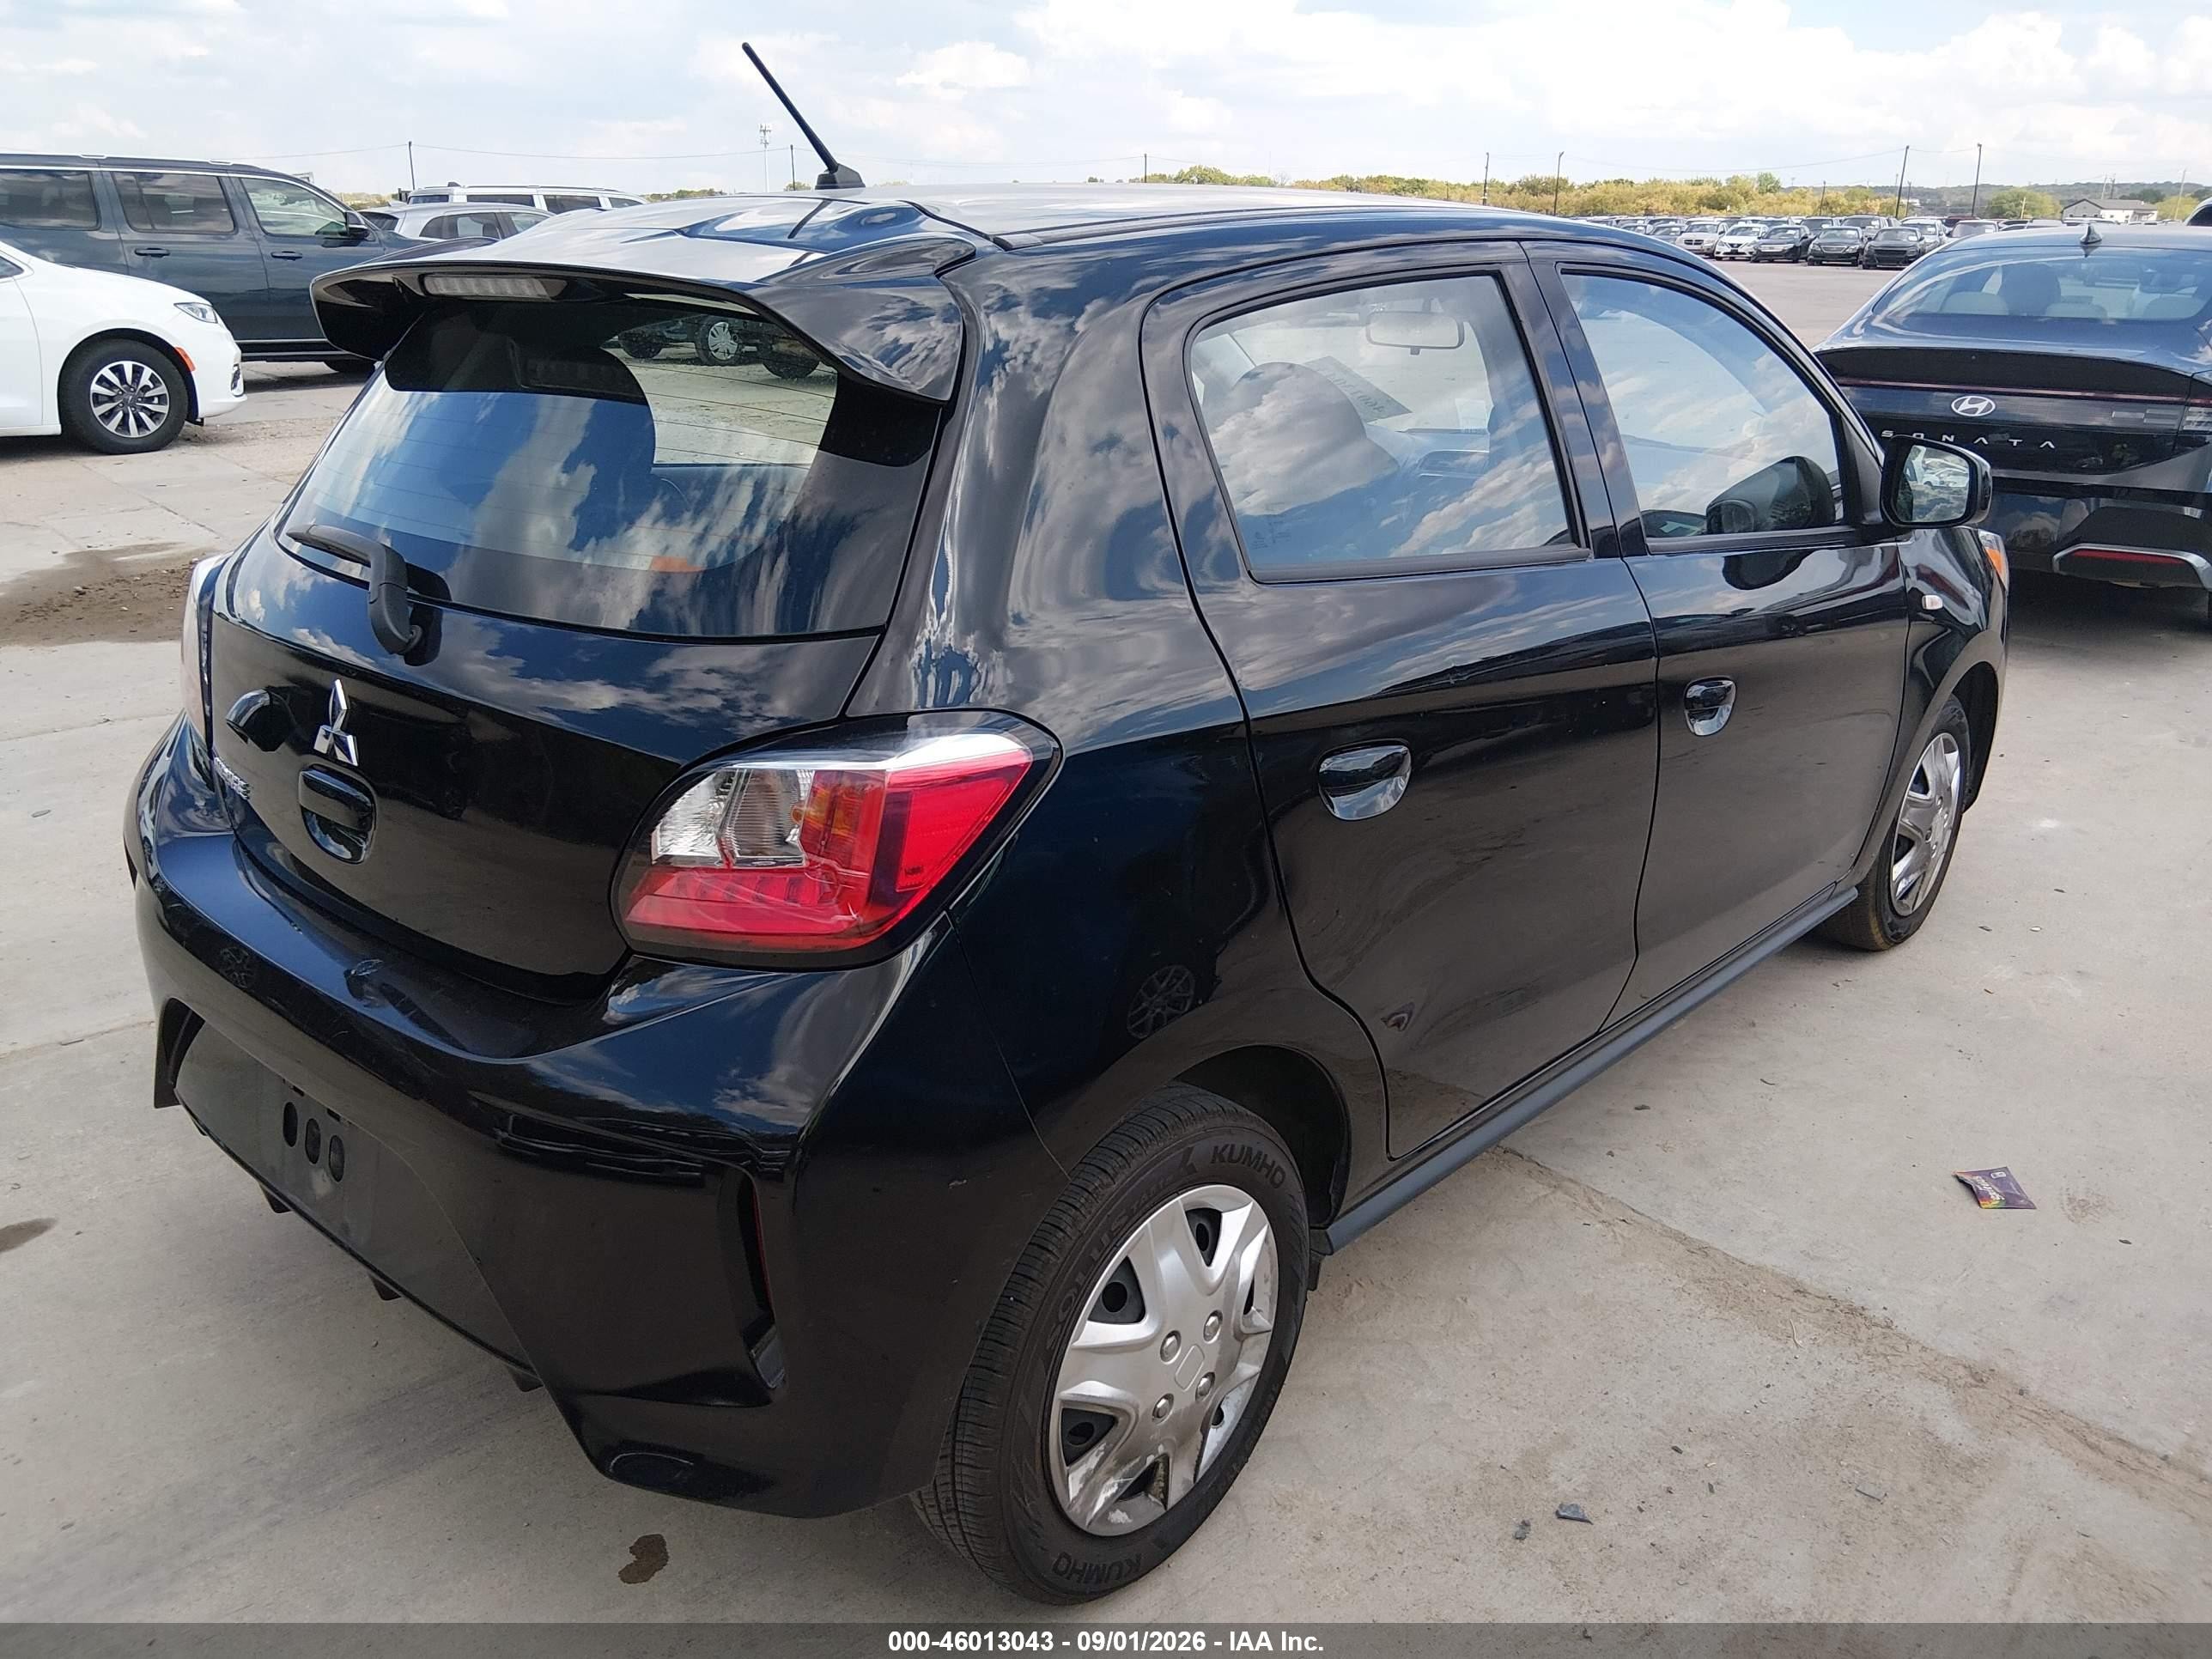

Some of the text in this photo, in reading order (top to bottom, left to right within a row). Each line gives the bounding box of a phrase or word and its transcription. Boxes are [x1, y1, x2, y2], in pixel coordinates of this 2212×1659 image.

[1881, 429, 2056, 449] SONATA
[1209, 1143, 1286, 1189] KUMHO
[1051, 1551, 1142, 1584] KUMHO
